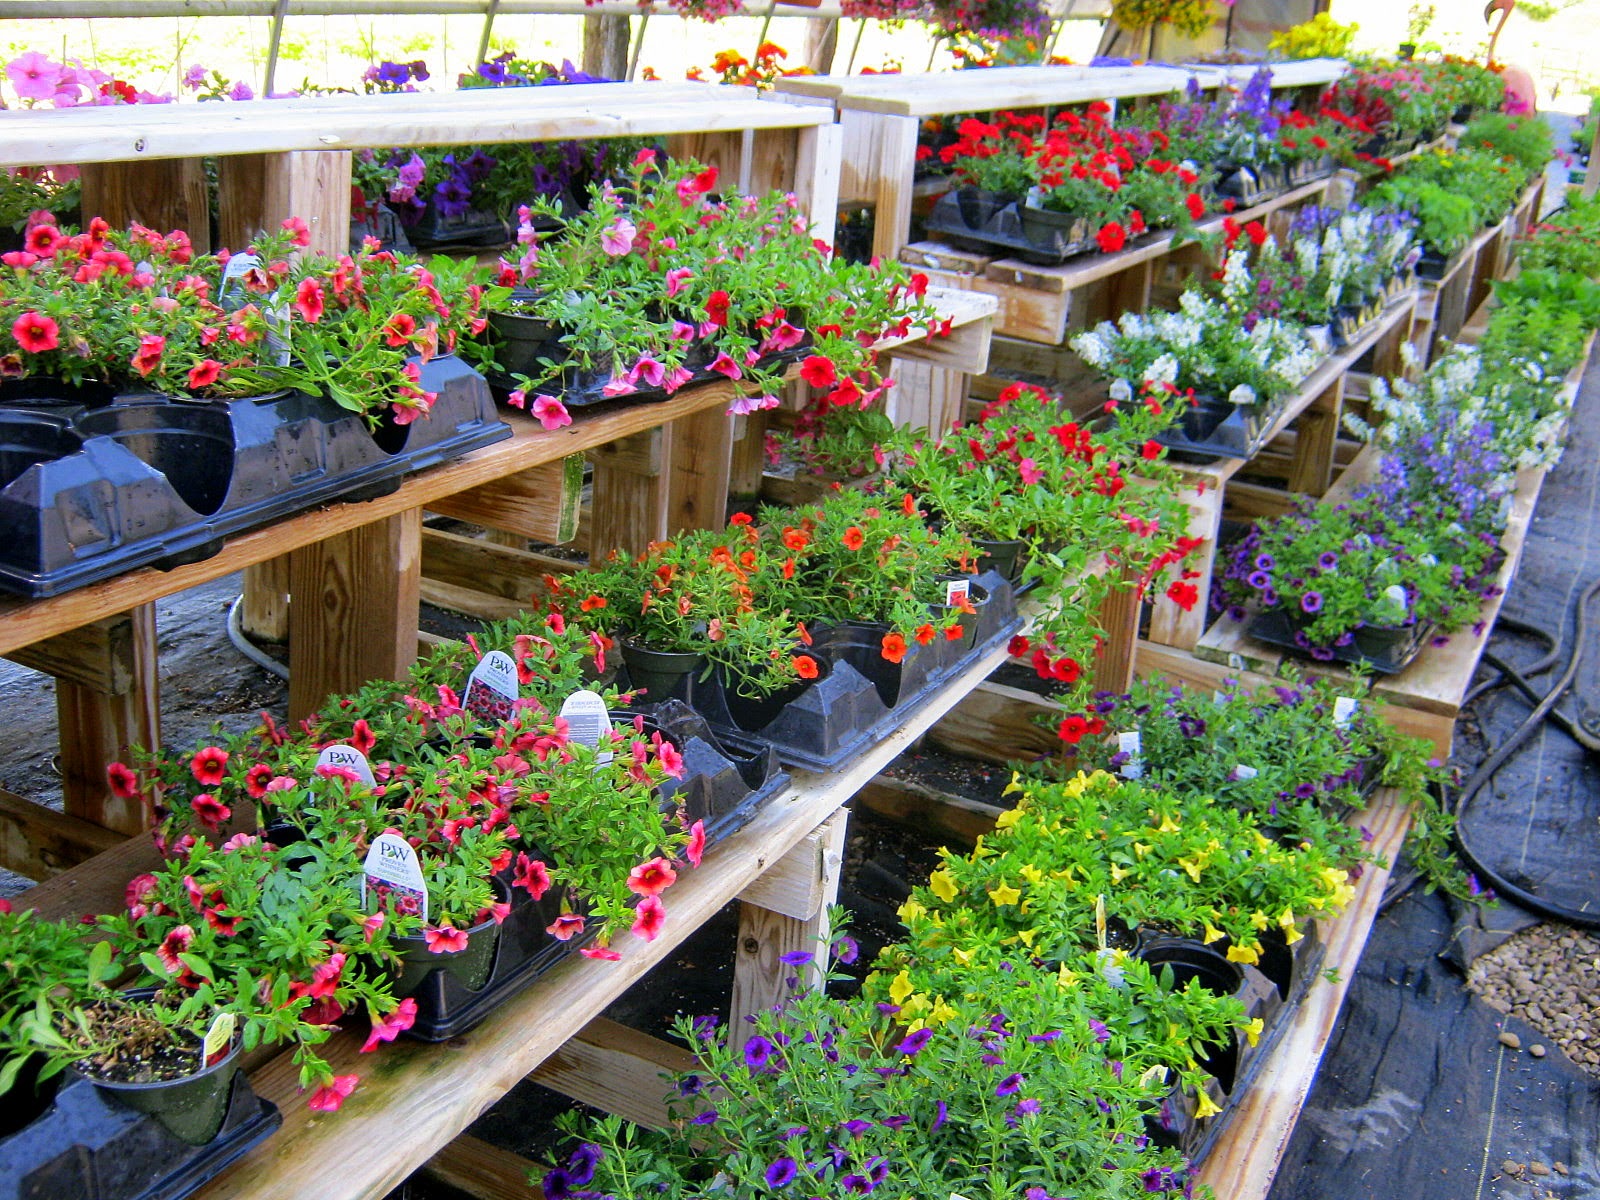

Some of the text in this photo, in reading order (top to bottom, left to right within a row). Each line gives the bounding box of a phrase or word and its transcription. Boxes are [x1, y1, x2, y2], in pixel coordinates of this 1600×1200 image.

[489, 655, 514, 674] PW
[329, 751, 359, 764] PW
[380, 841, 410, 861] PW
